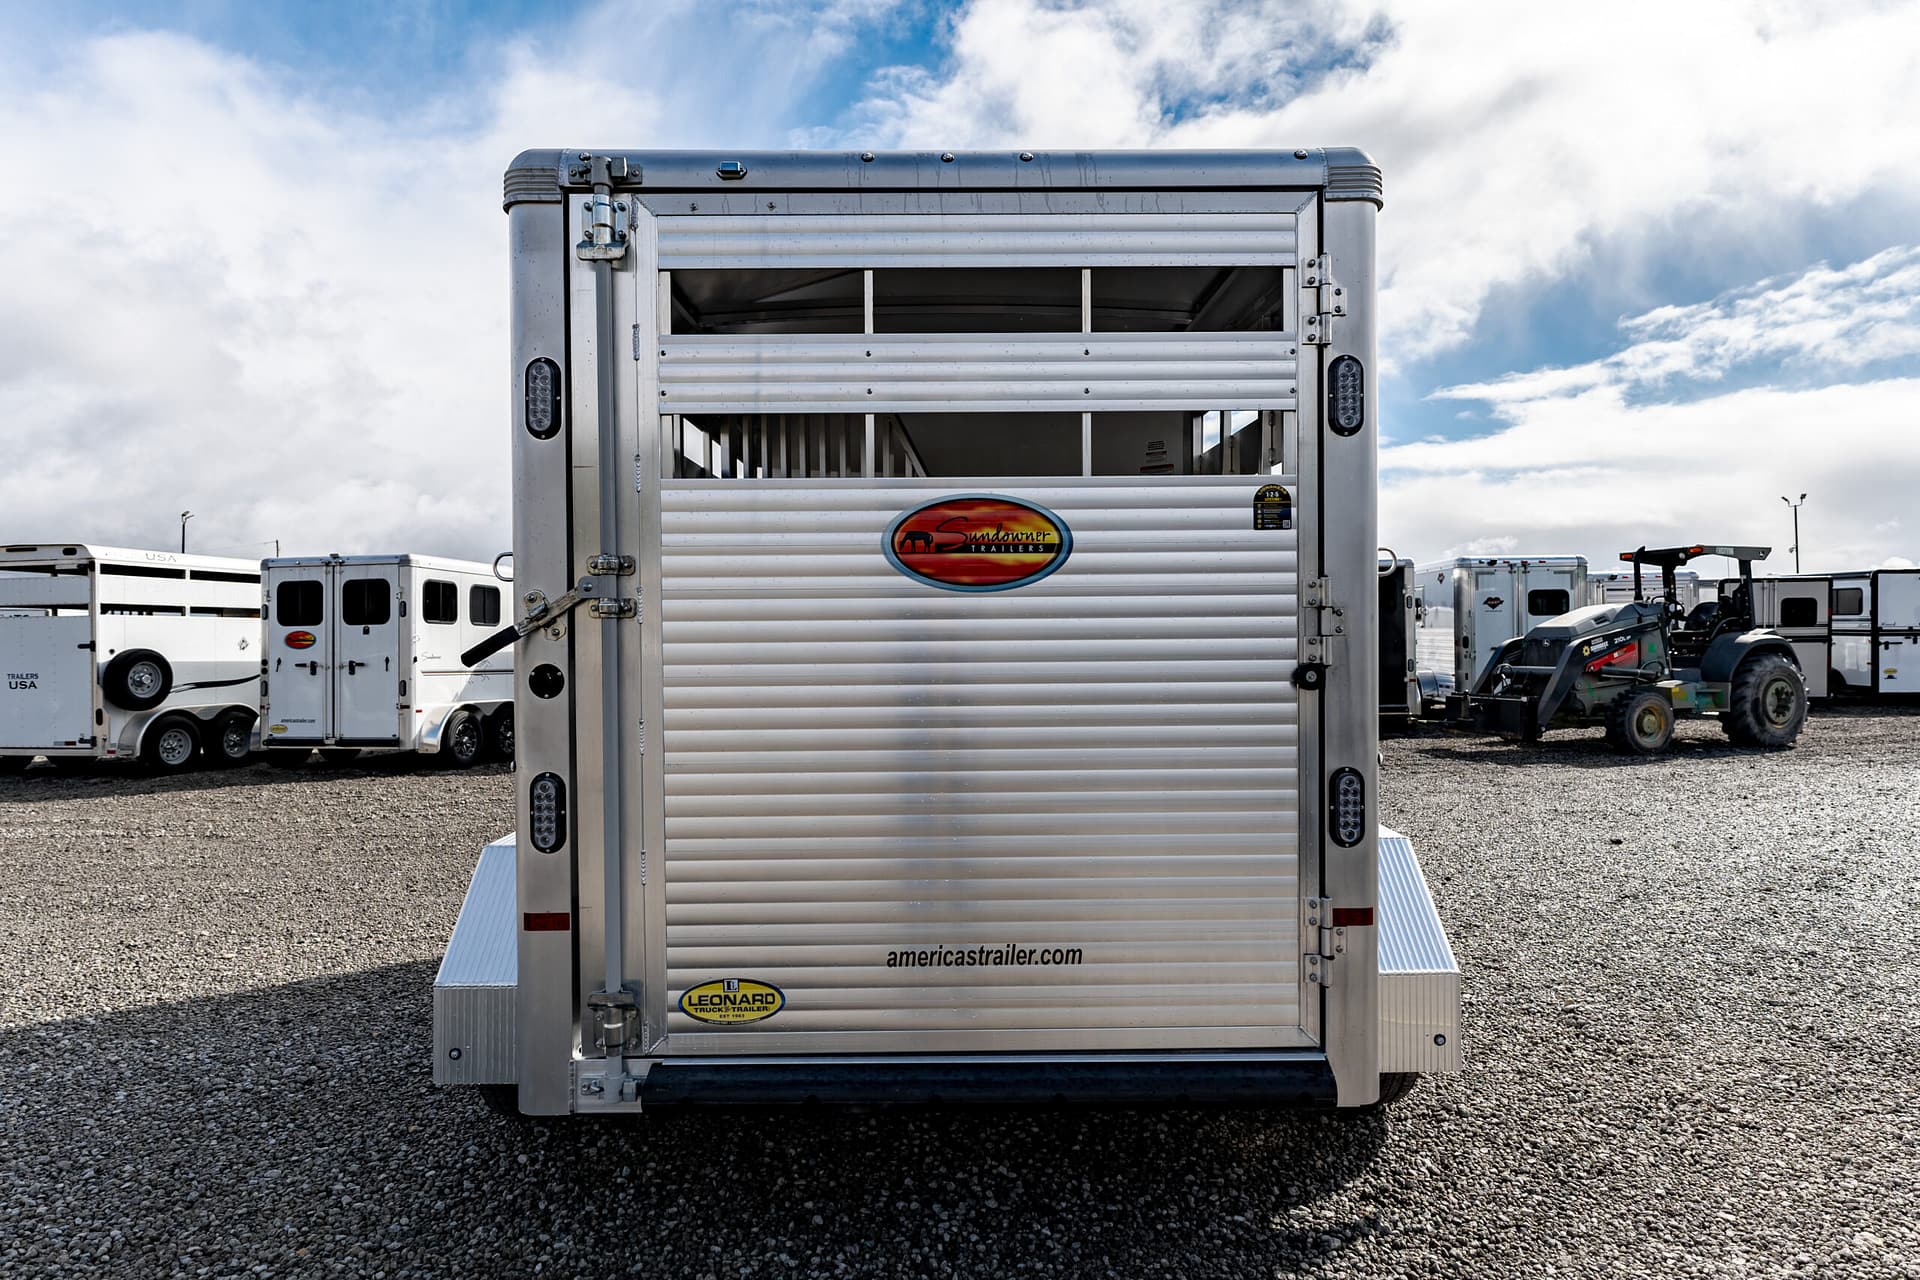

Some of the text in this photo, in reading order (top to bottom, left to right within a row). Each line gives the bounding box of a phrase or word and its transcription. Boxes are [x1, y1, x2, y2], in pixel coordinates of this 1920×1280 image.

[935, 516, 1051, 550] Sundowner
[971, 545, 1044, 553] TRAILERS
[145, 552, 177, 563] USA
[7, 672, 39, 680] TRAILERS
[8, 680, 38, 690] USA
[886, 943, 1083, 968] americastrailer.com
[688, 993, 775, 1007] LEONARD
